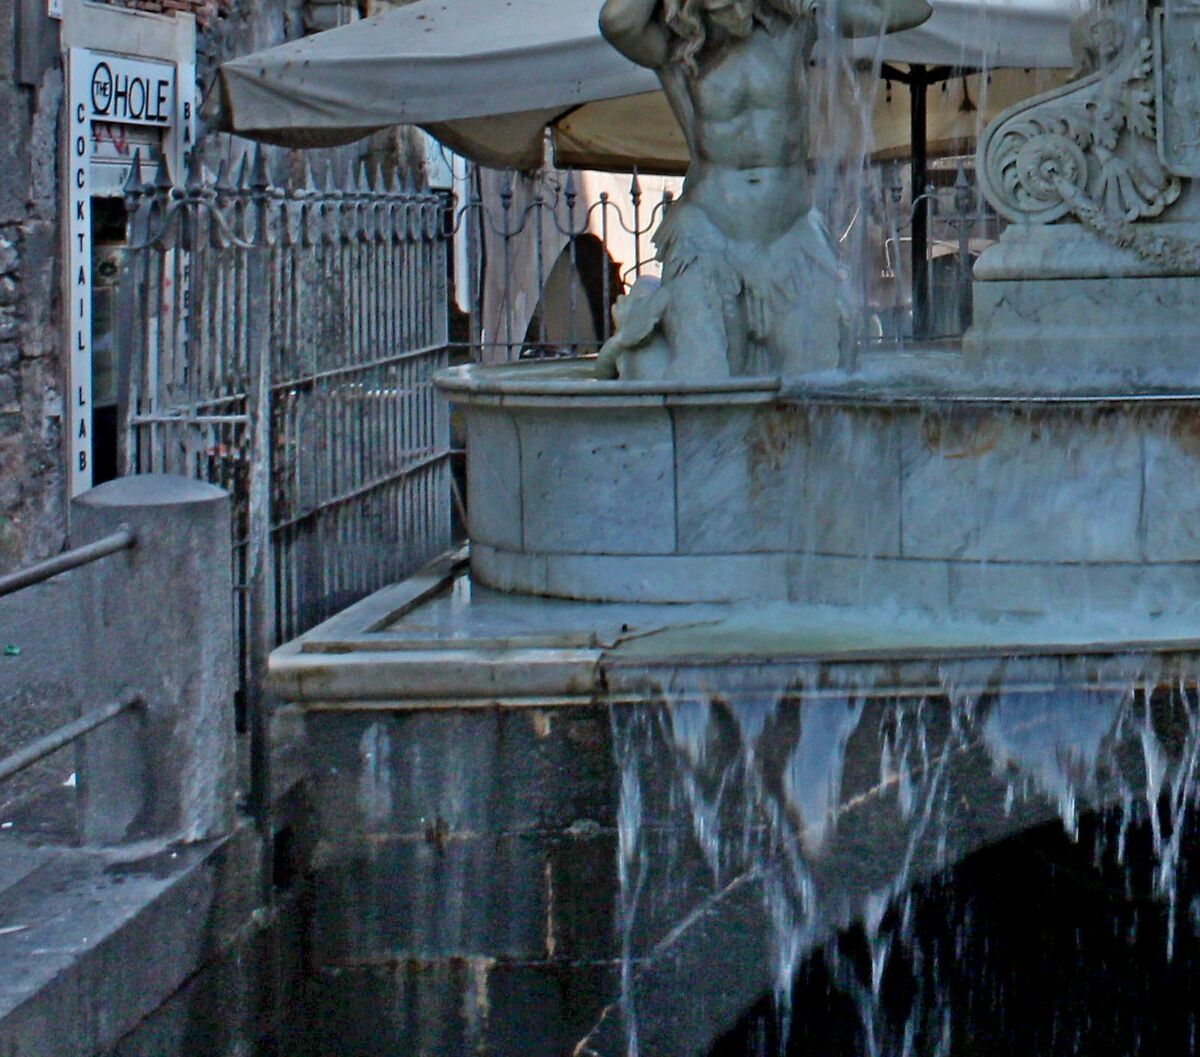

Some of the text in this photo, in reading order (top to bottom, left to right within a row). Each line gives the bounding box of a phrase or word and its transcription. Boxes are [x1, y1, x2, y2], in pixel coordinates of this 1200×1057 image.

[94, 73, 169, 122] THE HOLE
[77, 102, 87, 472] COCKTAIL LAB
